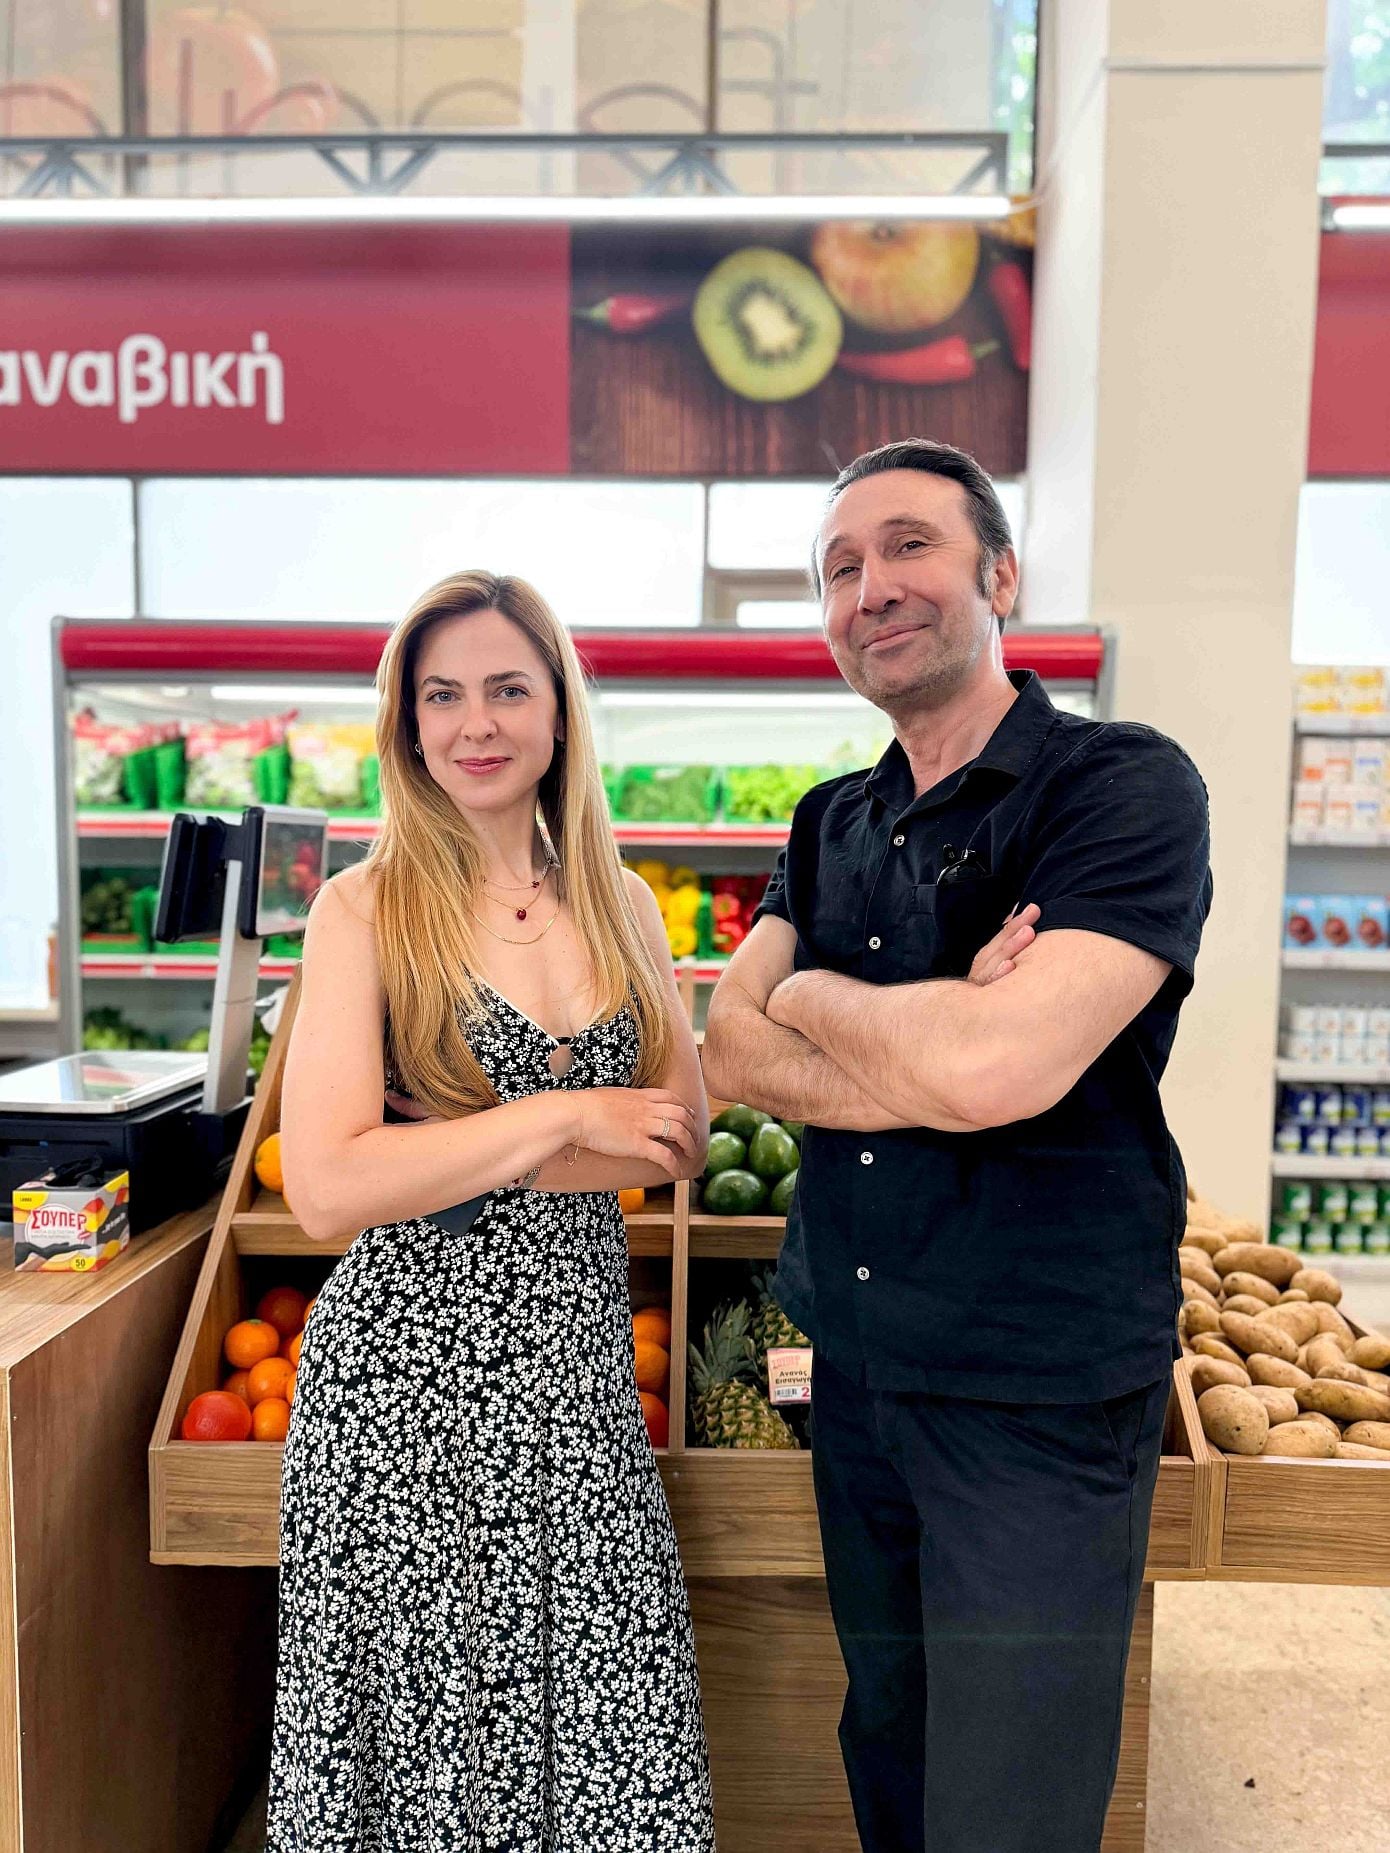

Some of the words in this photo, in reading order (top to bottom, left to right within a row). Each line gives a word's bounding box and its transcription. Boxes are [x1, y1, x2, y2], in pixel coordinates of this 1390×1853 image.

[31, 1210, 87, 1230] ΣΟΥΠΕΡ
[75, 1259, 86, 1267] 50
[801, 1386, 810, 1397] 2
